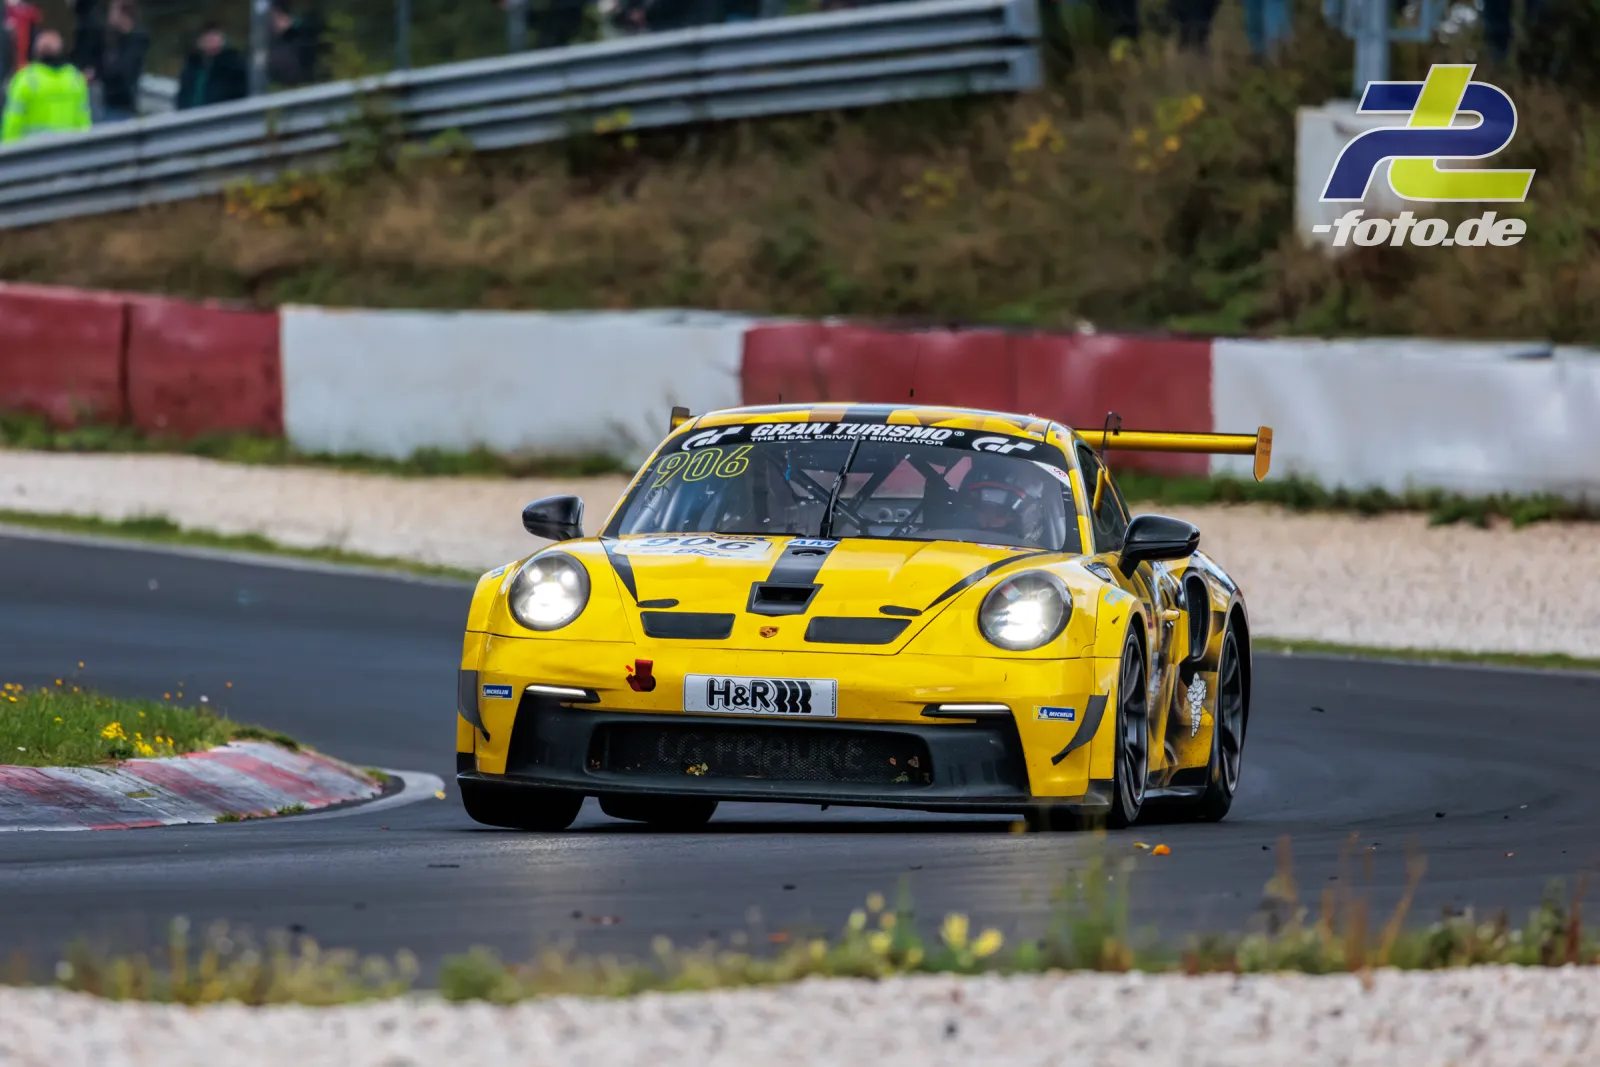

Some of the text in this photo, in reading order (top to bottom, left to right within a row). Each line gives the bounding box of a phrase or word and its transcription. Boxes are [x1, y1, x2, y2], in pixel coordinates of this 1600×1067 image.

[751, 423, 830, 438] GRAN
[869, 435, 944, 446] SIMULATOR
[651, 444, 755, 488] 906
[640, 537, 756, 550] 906
[707, 678, 776, 712] H&R
